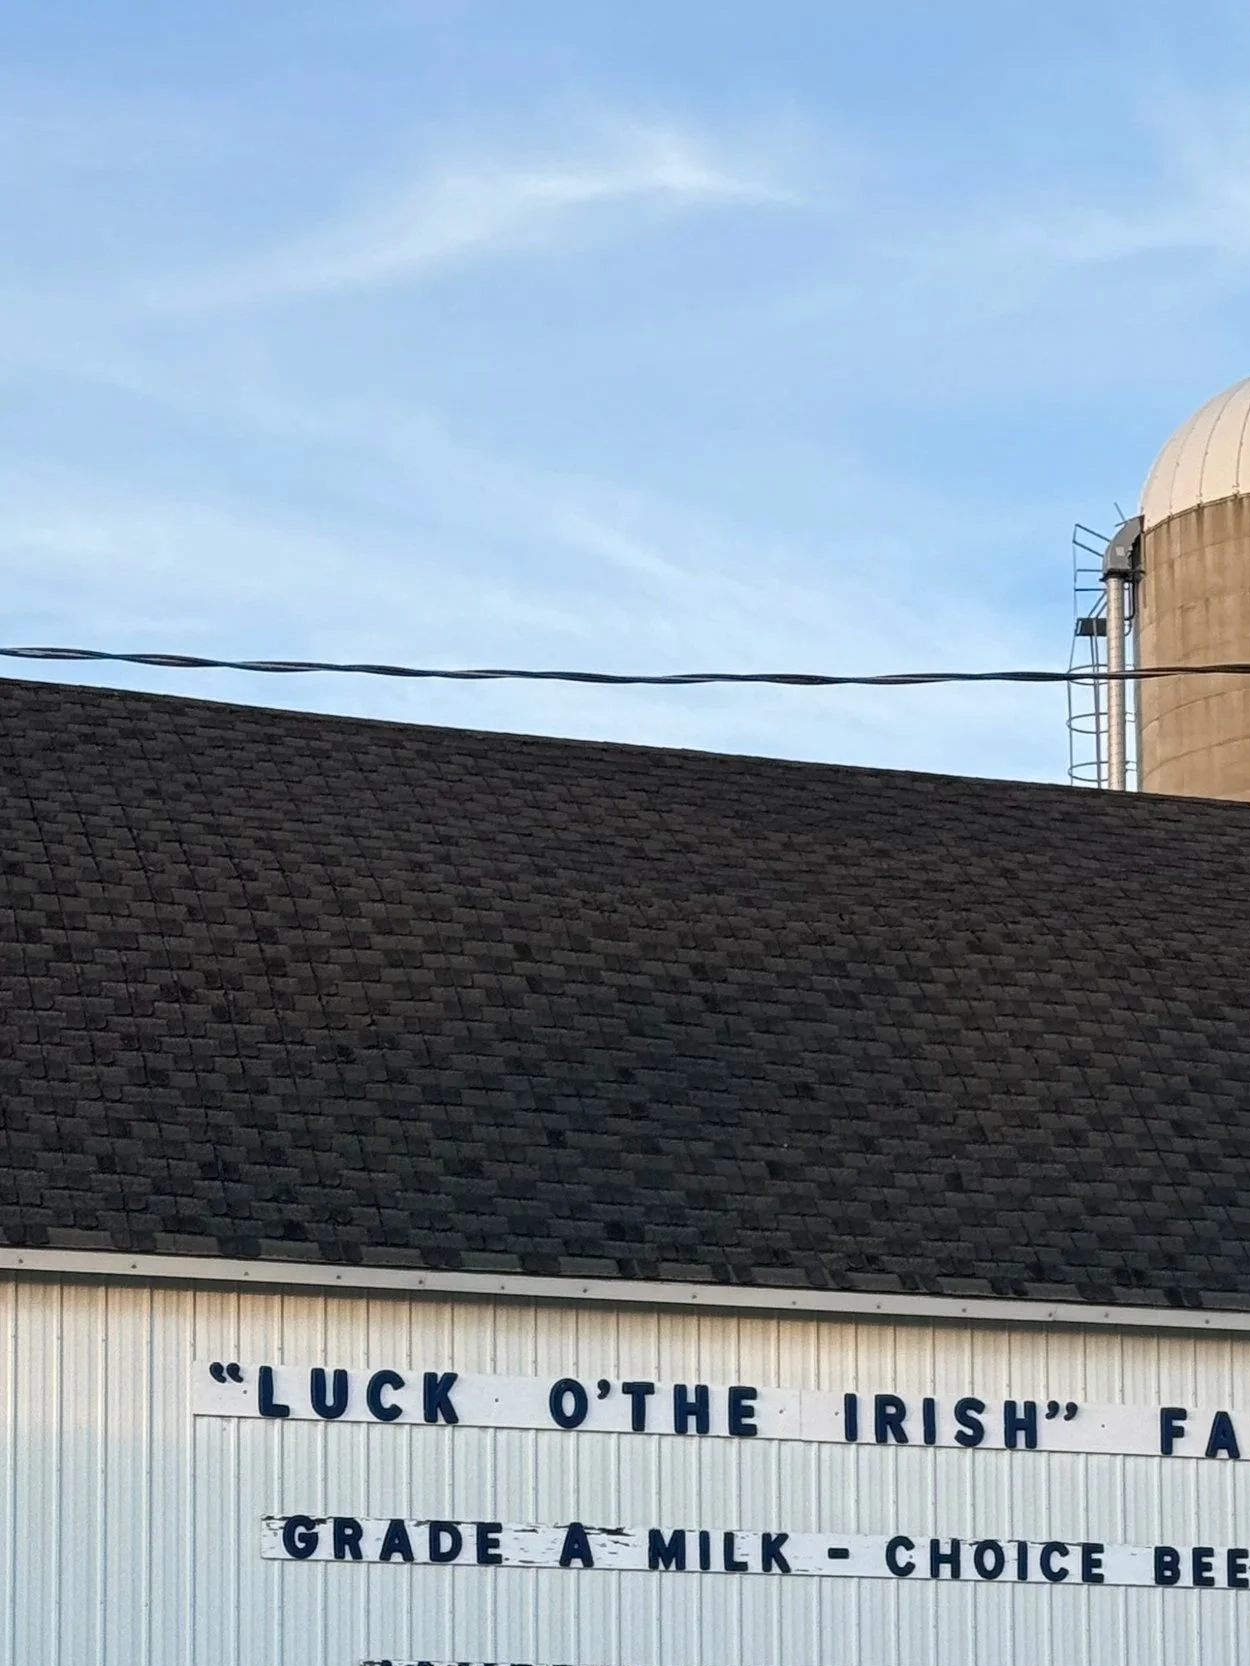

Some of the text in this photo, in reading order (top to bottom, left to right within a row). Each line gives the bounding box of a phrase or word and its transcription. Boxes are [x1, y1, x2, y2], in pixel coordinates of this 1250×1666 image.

[282, 1514, 503, 1565] GRADE
[558, 1522, 594, 1568] A
[648, 1528, 791, 1574] MILK
[885, 1535, 1104, 1584] CHOICE
